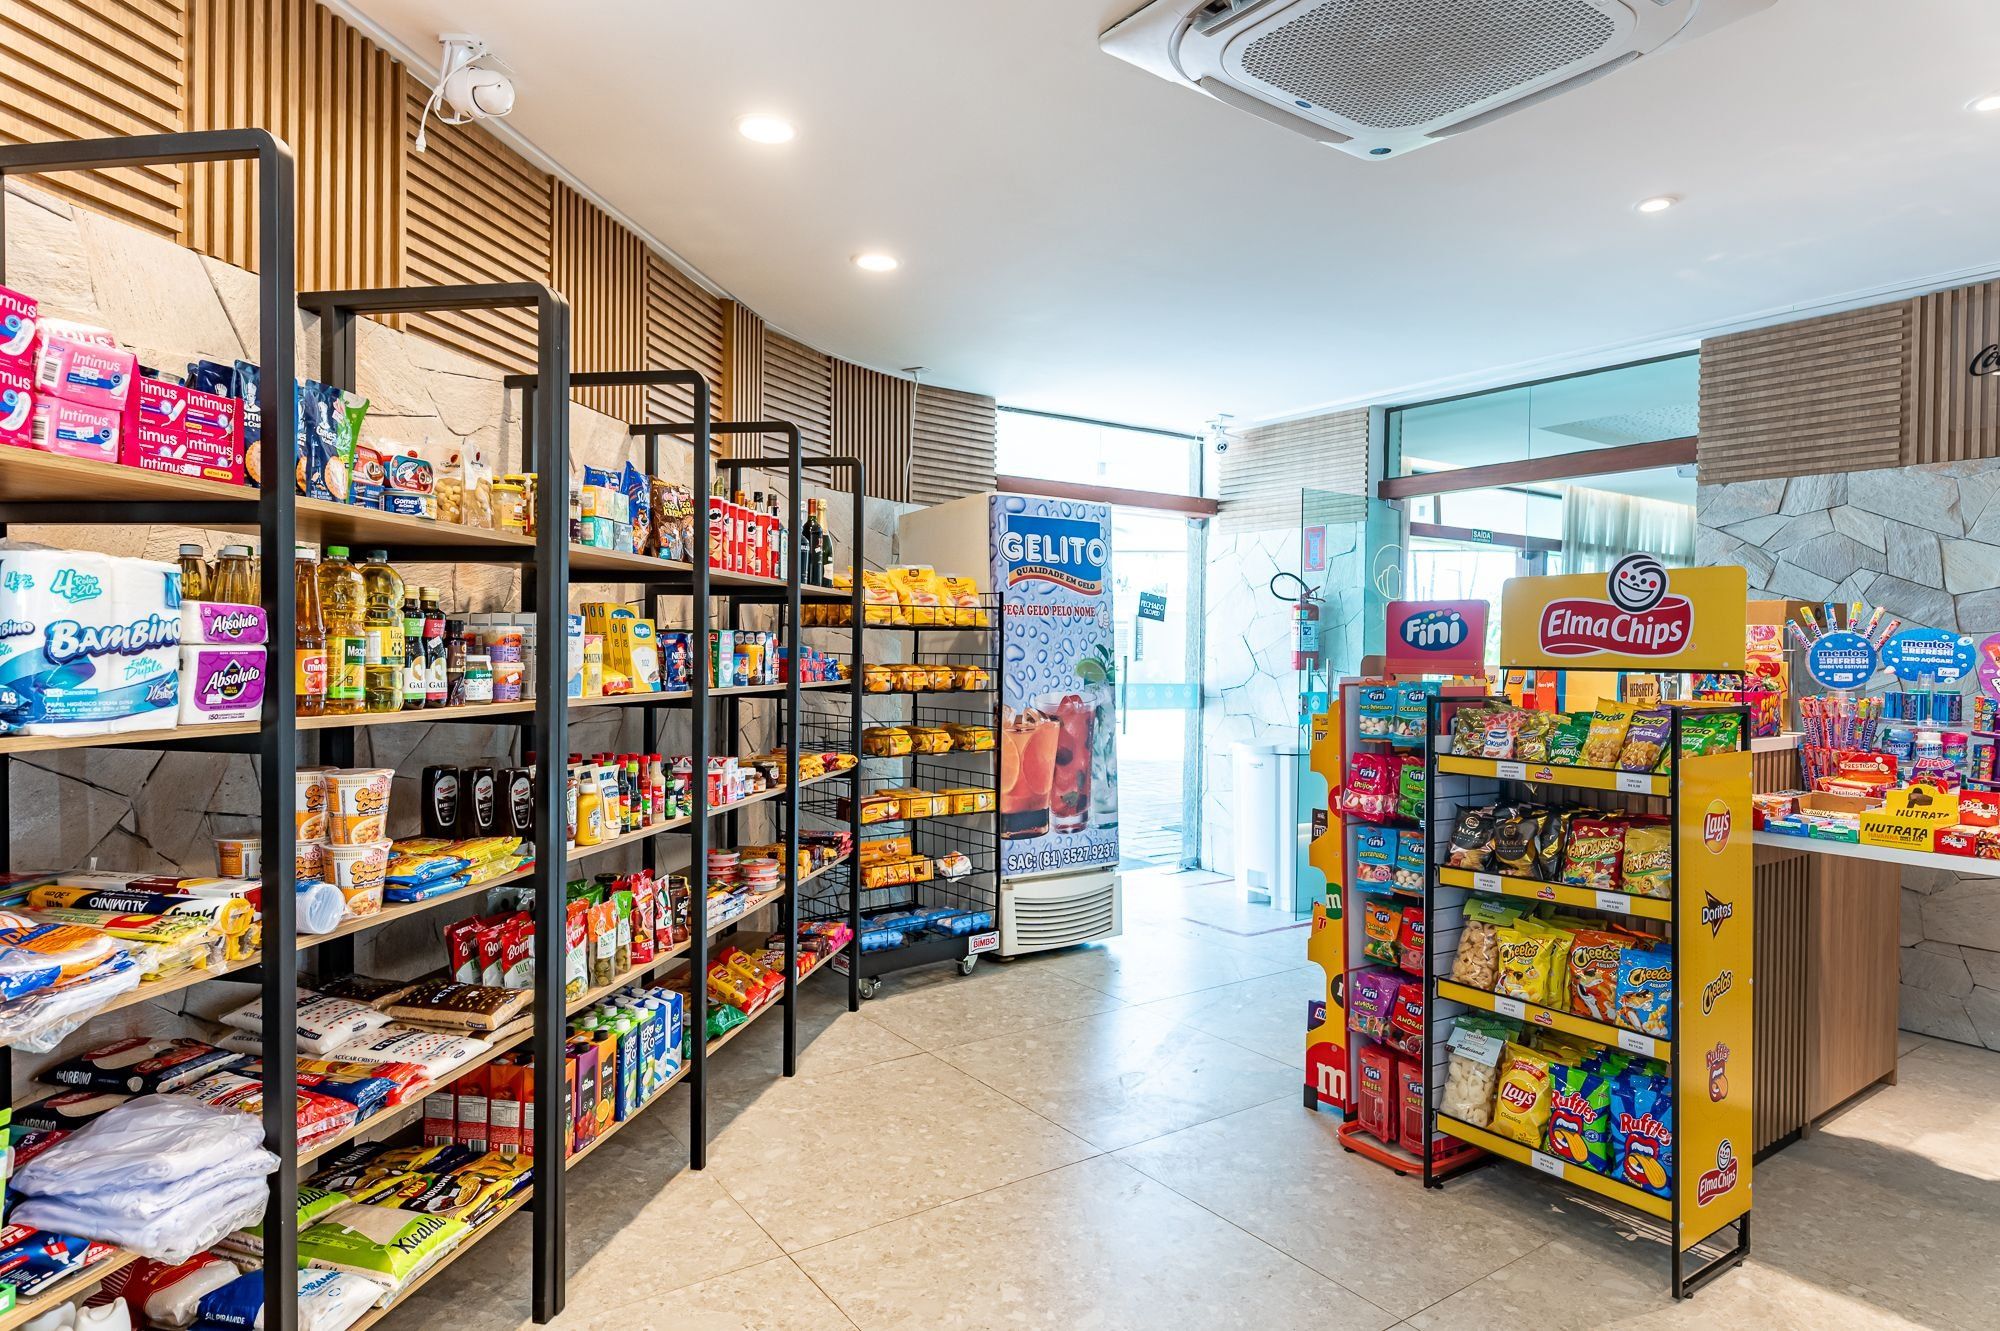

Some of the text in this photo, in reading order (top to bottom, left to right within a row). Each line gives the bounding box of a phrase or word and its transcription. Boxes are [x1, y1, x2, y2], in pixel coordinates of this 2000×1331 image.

[187, 391, 233, 415] Intimus
[59, 407, 110, 428] Intimus
[139, 455, 186, 475] Intimus
[393, 497, 419, 506] Gomes
[1473, 530, 1491, 540] SAÍDA
[999, 531, 1108, 567] GELITO
[1016, 566, 1096, 590] QUALIDADE EM GELO
[1003, 604, 1096, 618] PEÇA GELO PELO NOME
[1140, 600, 1165, 611] FECHADO
[210, 612, 259, 636] Absoluto
[1406, 611, 1460, 646] Fini
[1818, 650, 1868, 658] mentos
[1902, 640, 1954, 650] mentos
[1909, 648, 1954, 656] REFRESH!
[1826, 657, 1869, 665] REFRESH
[203, 666, 261, 695] Absoluto
[1629, 683, 1654, 698] HERSHEY'S
[1704, 812, 1730, 842] Lay's
[1864, 822, 1928, 839] NUTRATA
[1008, 842, 1116, 871] SAC: (81) 3527.9237
[89, 896, 149, 913] ALUMÍNIO
[1702, 901, 1733, 925] Doritos
[973, 937, 996, 948] BIMBO
[1499, 941, 1539, 963] Cheetos
[1572, 944, 1621, 968] Cheetos
[1628, 966, 1672, 987] Cheetos
[1702, 970, 1733, 1016] Cheetos
[1706, 1041, 1731, 1070] Ruffles
[1409, 1082, 1423, 1095] Fin
[1502, 1082, 1537, 1107] Lay's
[1551, 1090, 1598, 1124] Ruffles
[1620, 1113, 1672, 1146] Ruffles
[392, 1216, 447, 1255] Kicaldo
